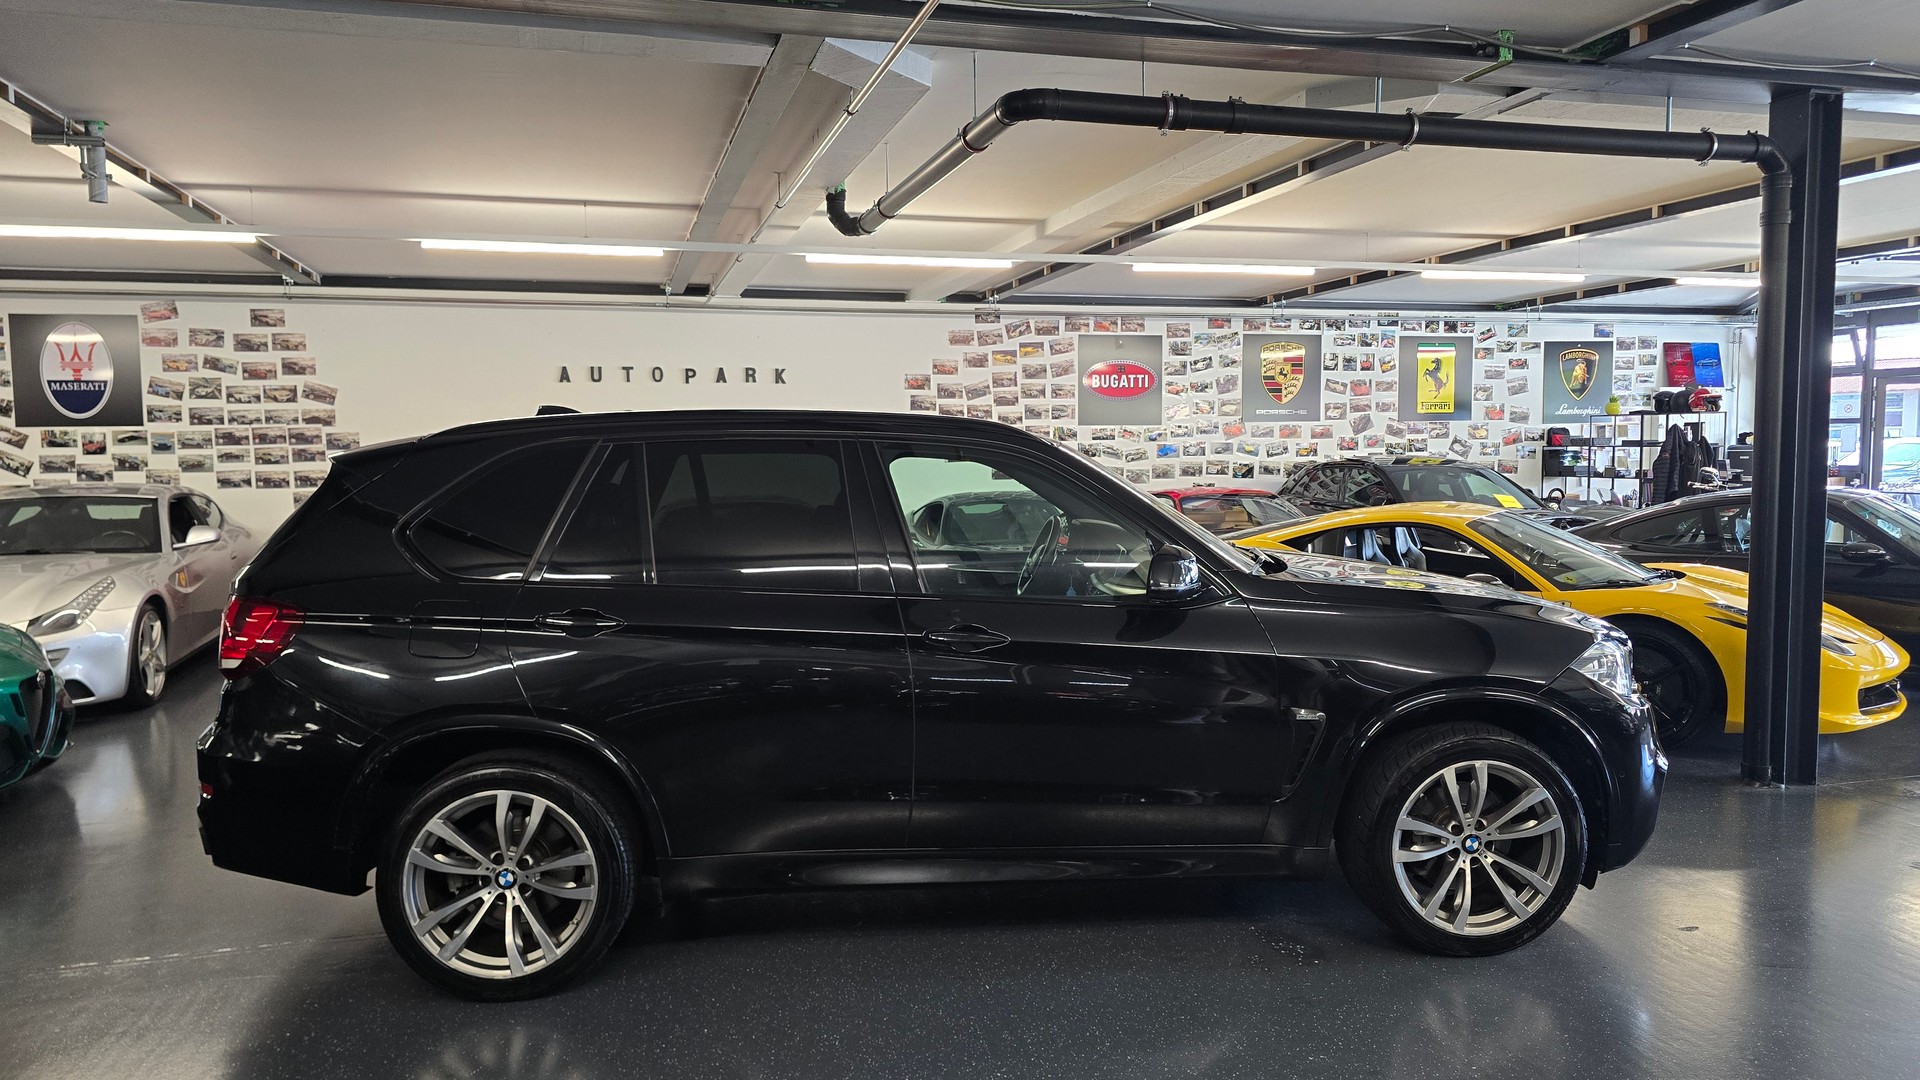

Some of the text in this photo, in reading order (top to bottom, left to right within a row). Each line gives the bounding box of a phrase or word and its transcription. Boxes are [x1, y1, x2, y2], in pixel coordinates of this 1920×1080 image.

[558, 366, 787, 384] AUTOPARK
[1091, 374, 1149, 388] BUGATTI
[51, 382, 105, 391] MASERATI
[1420, 401, 1451, 410] Ferrari
[1555, 403, 1602, 417] Lamborghini
